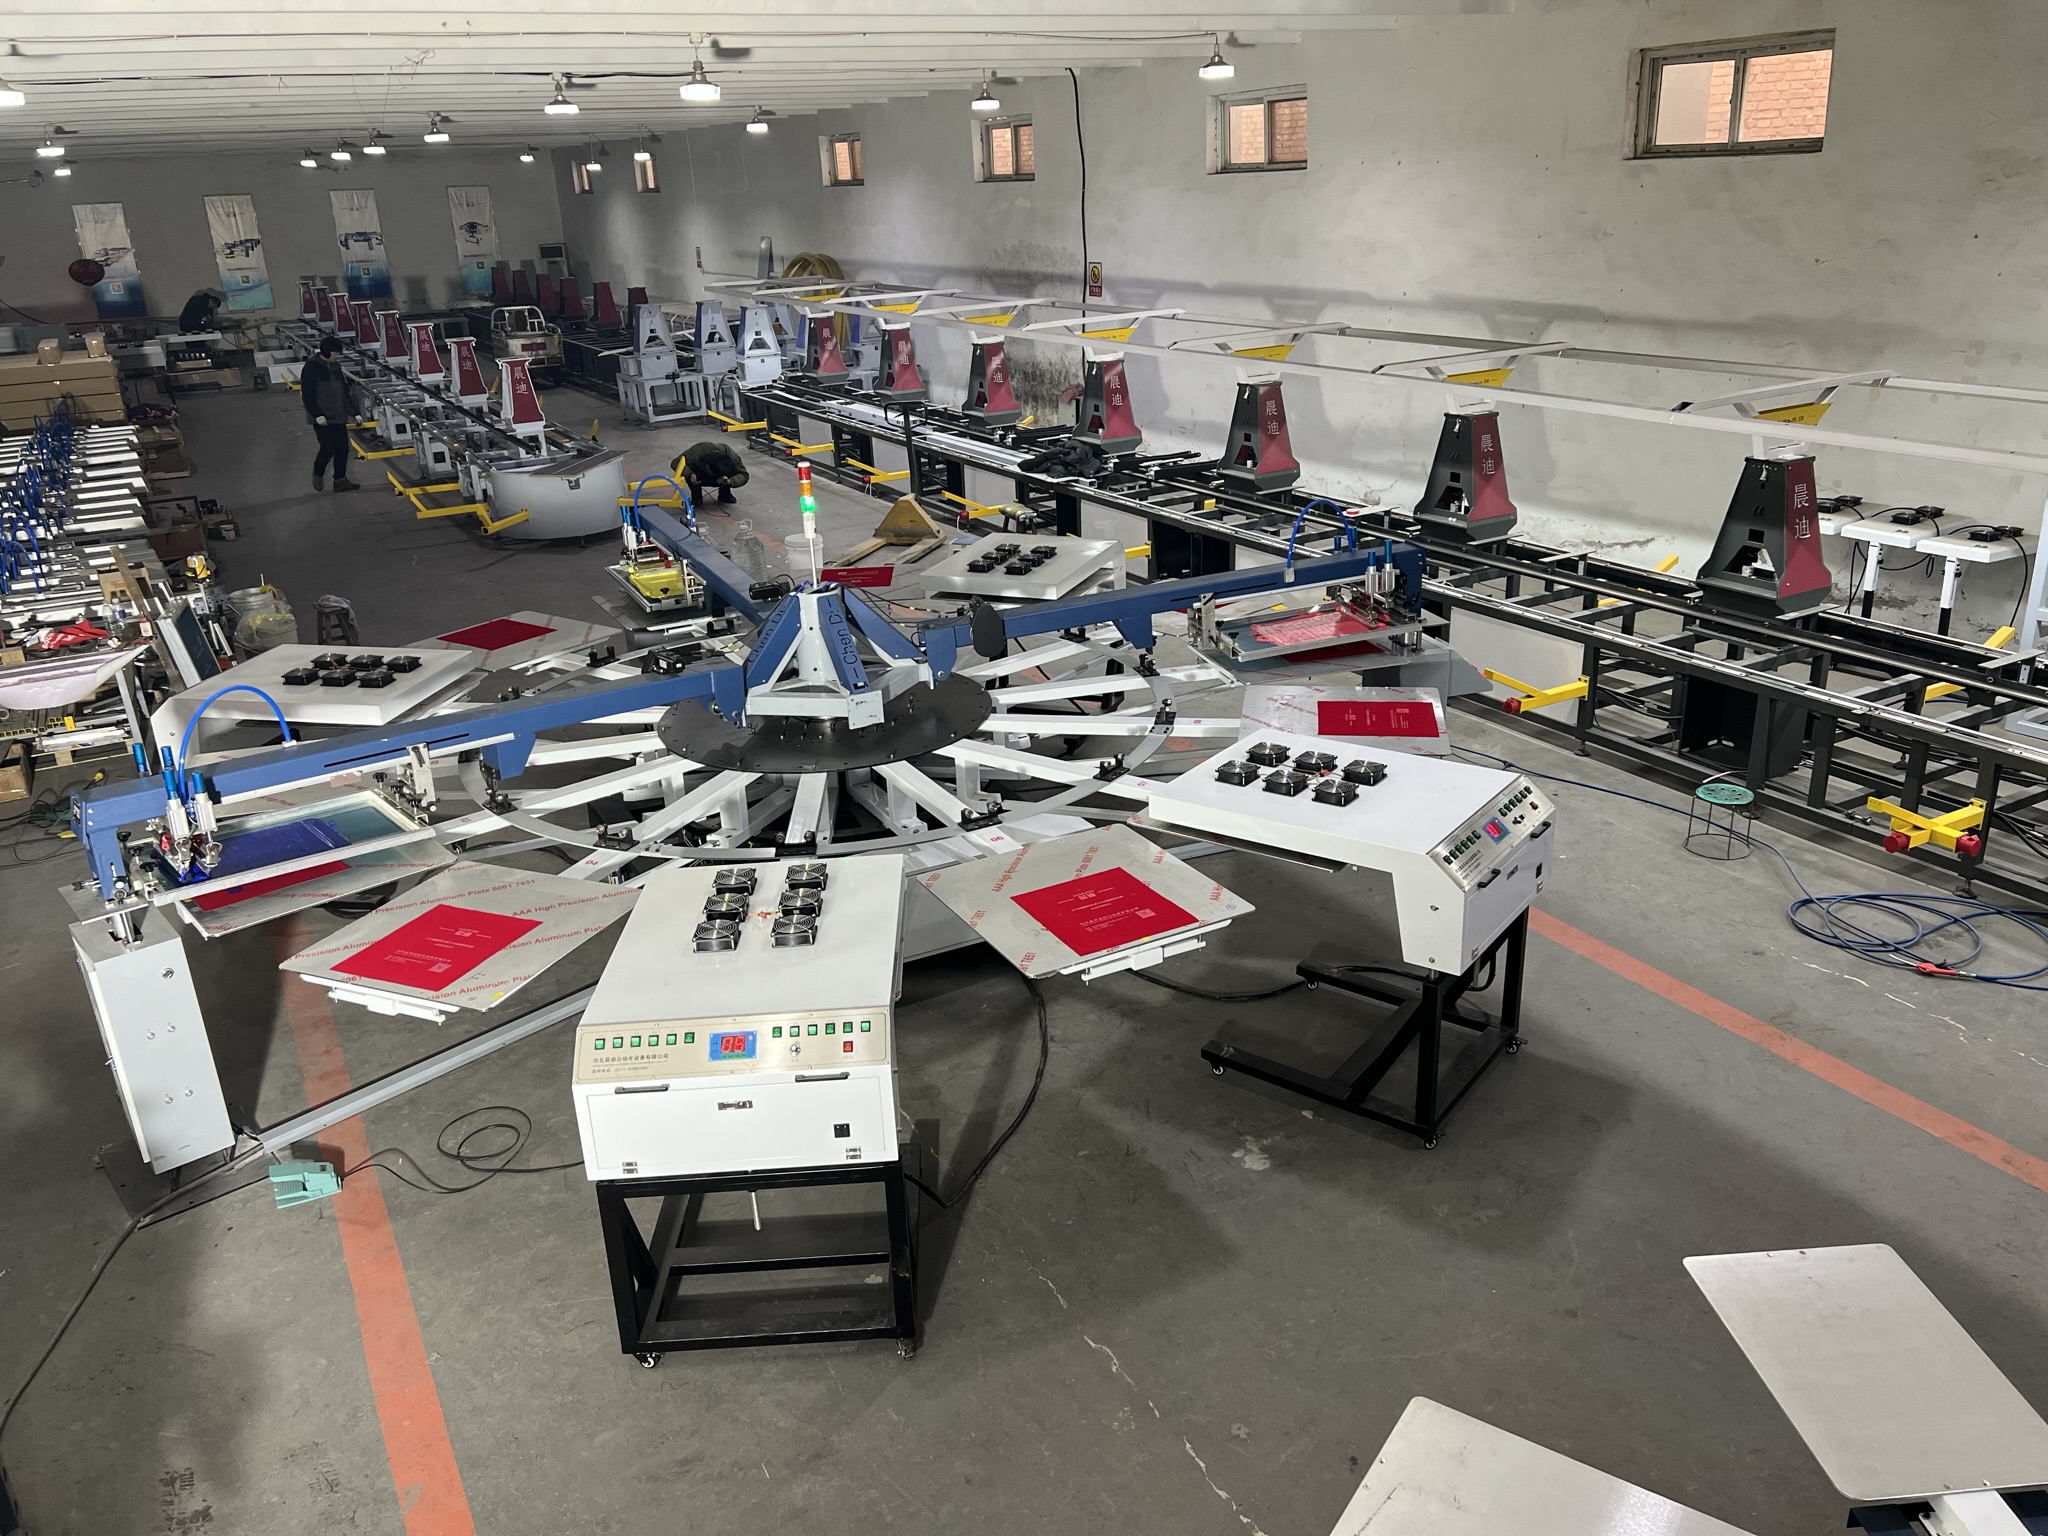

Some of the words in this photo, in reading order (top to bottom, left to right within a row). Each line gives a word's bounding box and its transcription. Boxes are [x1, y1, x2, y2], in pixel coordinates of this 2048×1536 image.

[419, 331, 432, 353] 晨迪
[822, 327, 834, 351] 晨迪
[460, 345, 474, 371] 晨迪
[897, 341, 910, 366] 晨迪
[513, 365, 529, 395] 晨迪
[991, 356, 1004, 384] 晨迪
[1109, 375, 1123, 407] 晨迪
[1265, 400, 1280, 436] 晨迪
[1480, 433, 1496, 476] 晨迪
[1792, 483, 1812, 540] 晨迪
[826, 609, 843, 625] Di
[748, 628, 775, 663] Chen
[771, 610, 786, 624] Di
[836, 628, 858, 665] Chen
[374, 902, 418, 915] Precision
[420, 893, 466, 905] Aluminum
[467, 888, 490, 896] Plate
[492, 883, 512, 891] 6061
[515, 879, 535, 887] T651
[512, 908, 533, 917] AAA
[534, 903, 556, 912] High
[558, 895, 600, 908] Precision
[602, 888, 641, 899] Aluminu
[295, 946, 340, 959] Precision
[504, 940, 532, 951] cision
[534, 930, 582, 944] Aluminum
[458, 980, 510, 995] Aluminum
